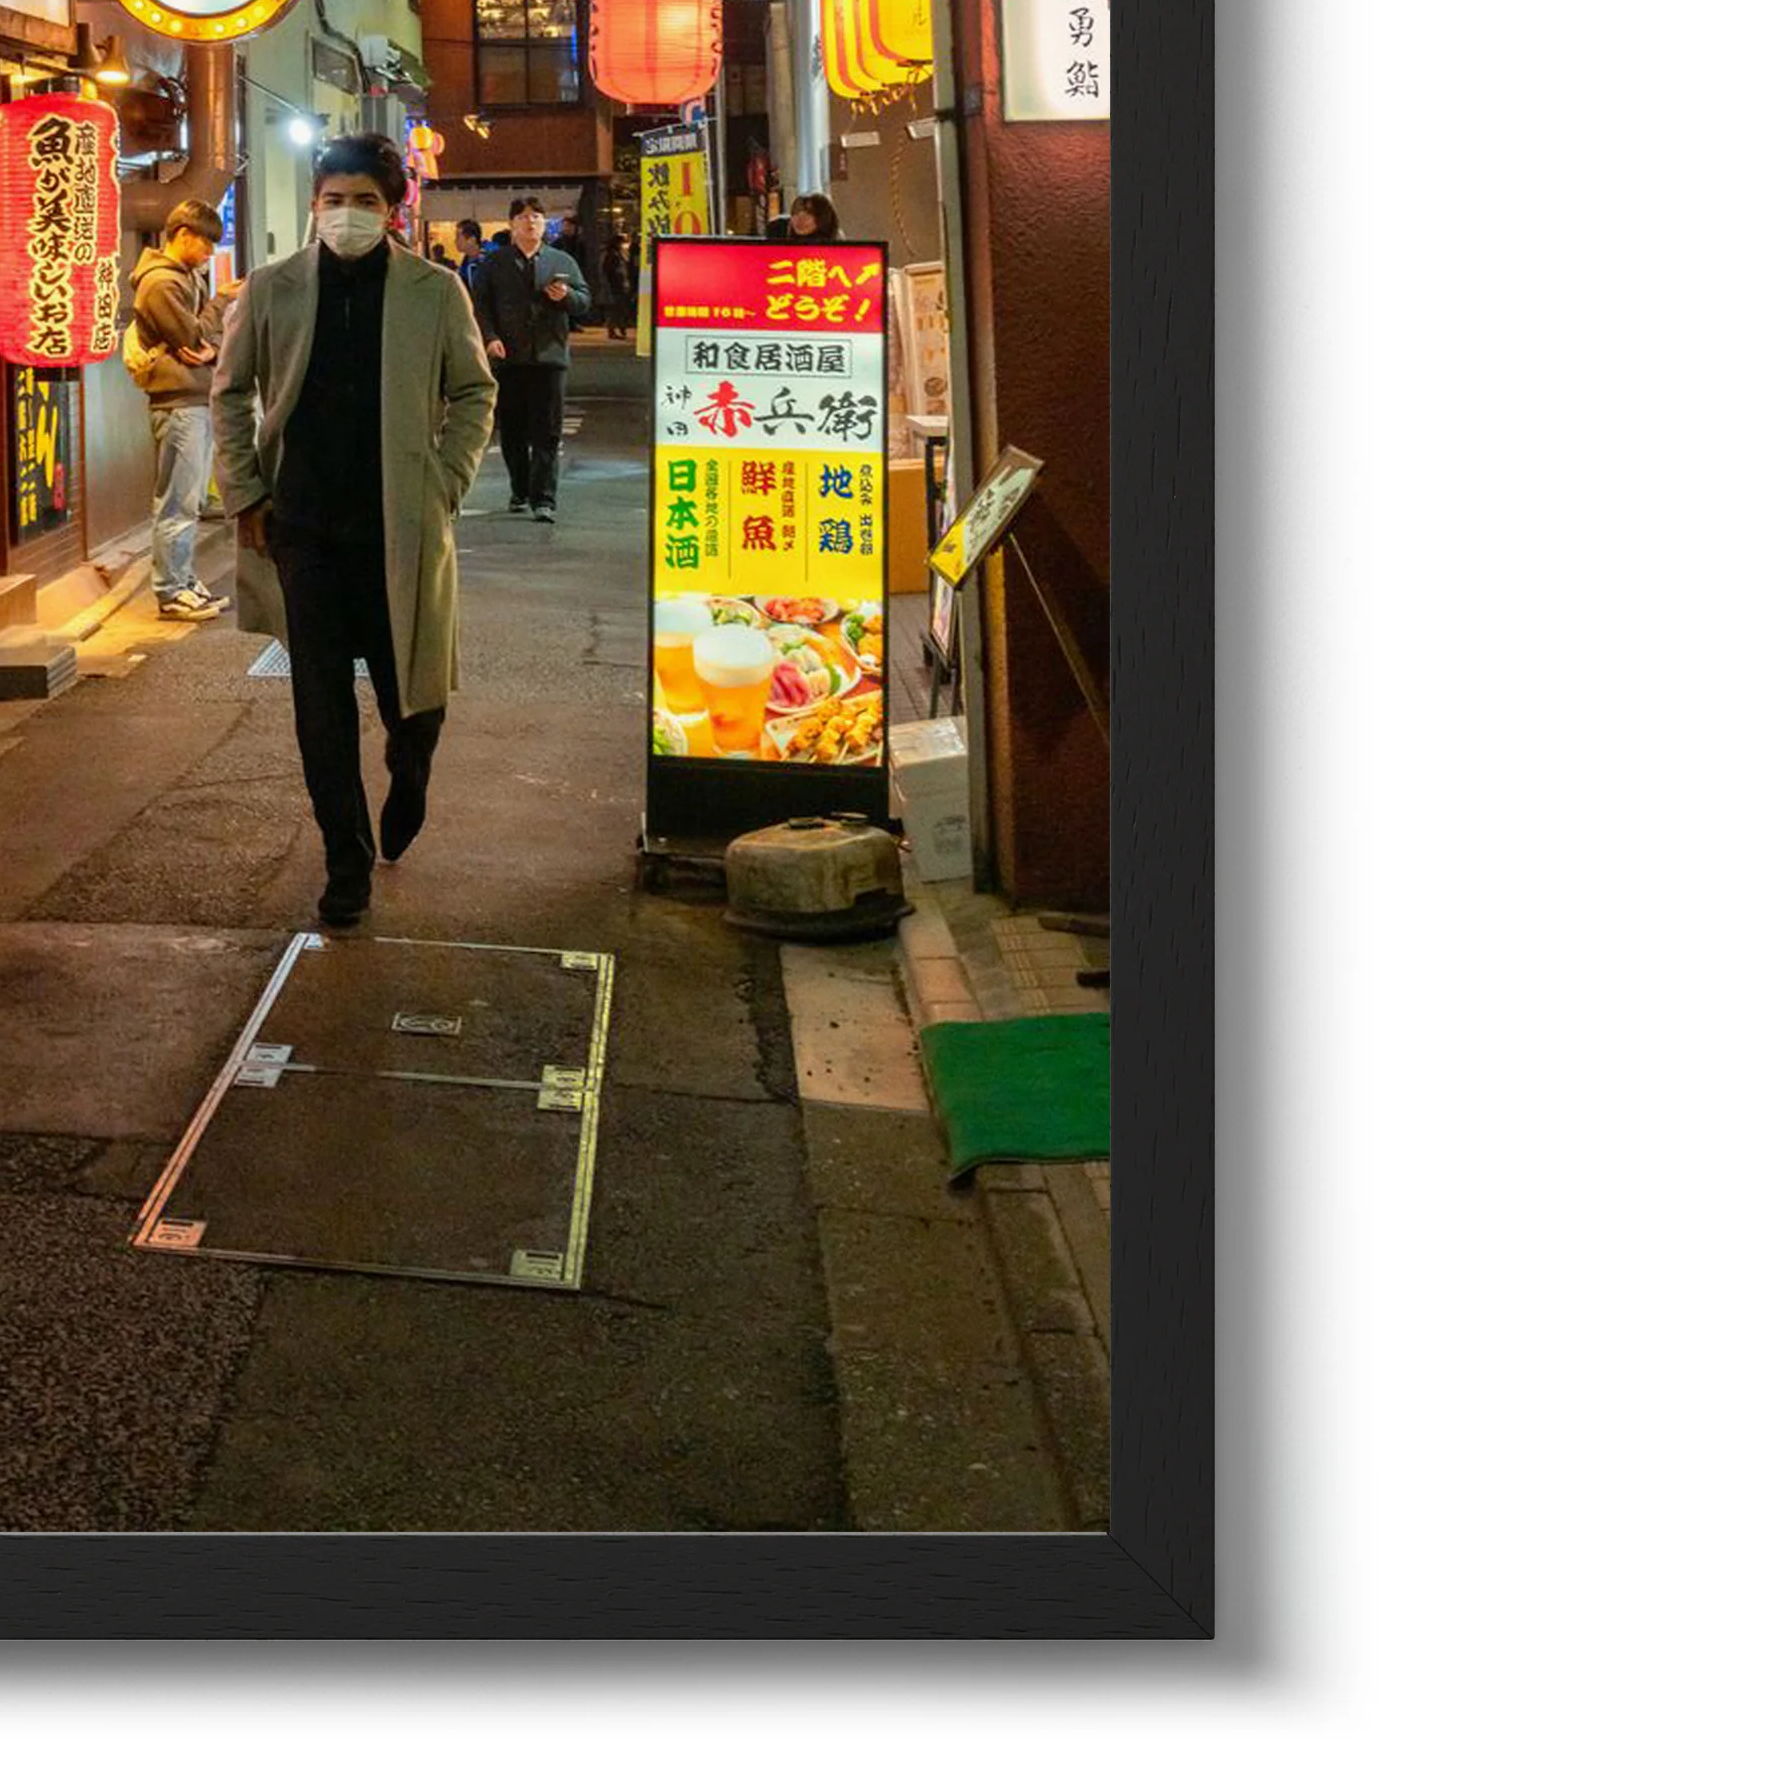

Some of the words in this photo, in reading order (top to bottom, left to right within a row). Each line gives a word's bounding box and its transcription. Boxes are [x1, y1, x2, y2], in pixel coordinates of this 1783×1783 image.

[30, 116, 73, 355] 魚が美味しいお店
[73, 122, 97, 262] 産地直送の
[766, 294, 871, 322] どうぞ！
[767, 259, 853, 289] 二階へ
[693, 341, 846, 374] 和食居酒屋
[694, 380, 879, 442] 赤兵衛
[665, 458, 700, 570] 日本酒
[741, 460, 777, 552] 鮮魚
[819, 463, 854, 554] 地鶏
